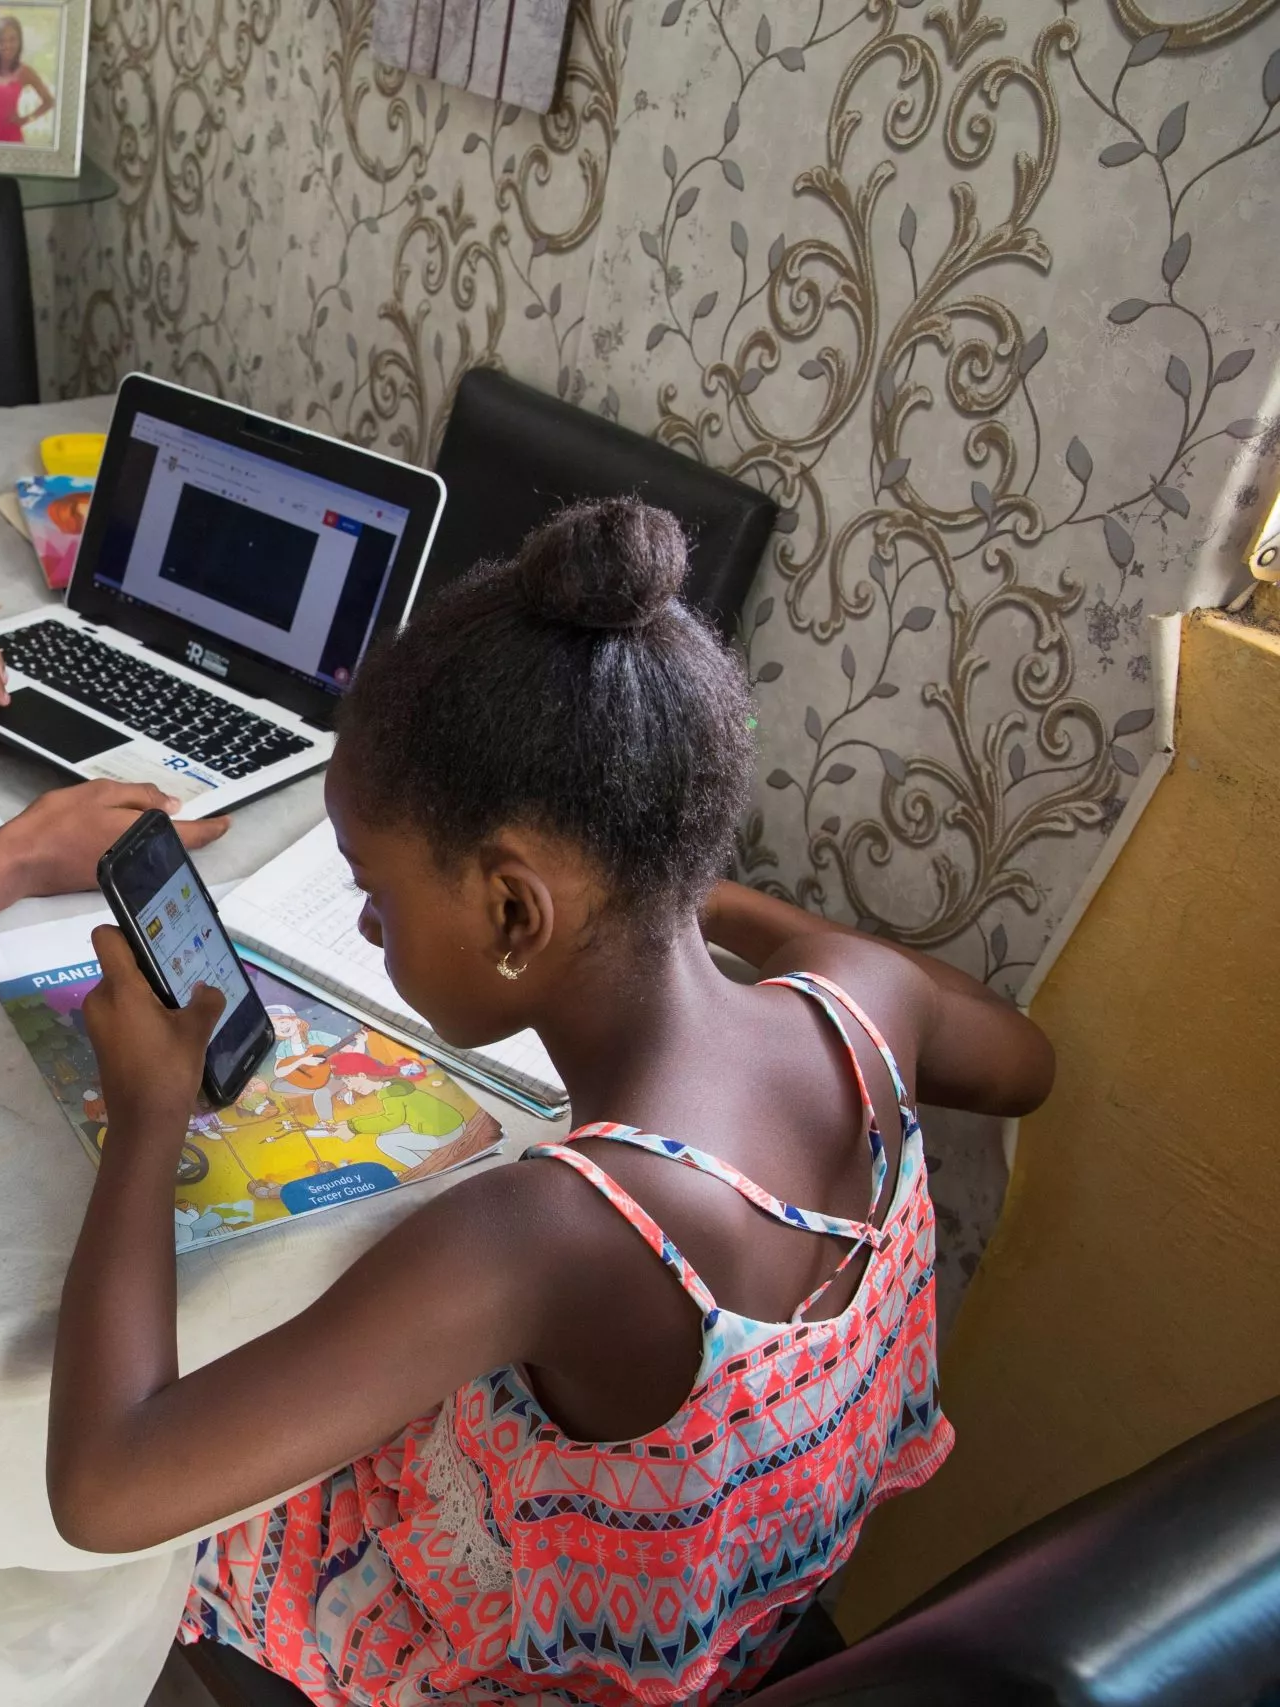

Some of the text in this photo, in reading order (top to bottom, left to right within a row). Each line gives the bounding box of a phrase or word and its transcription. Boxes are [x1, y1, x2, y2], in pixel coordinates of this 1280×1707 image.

[308, 1173, 362, 1195] Segundo y
[308, 1181, 376, 1206] Tercer Grado
